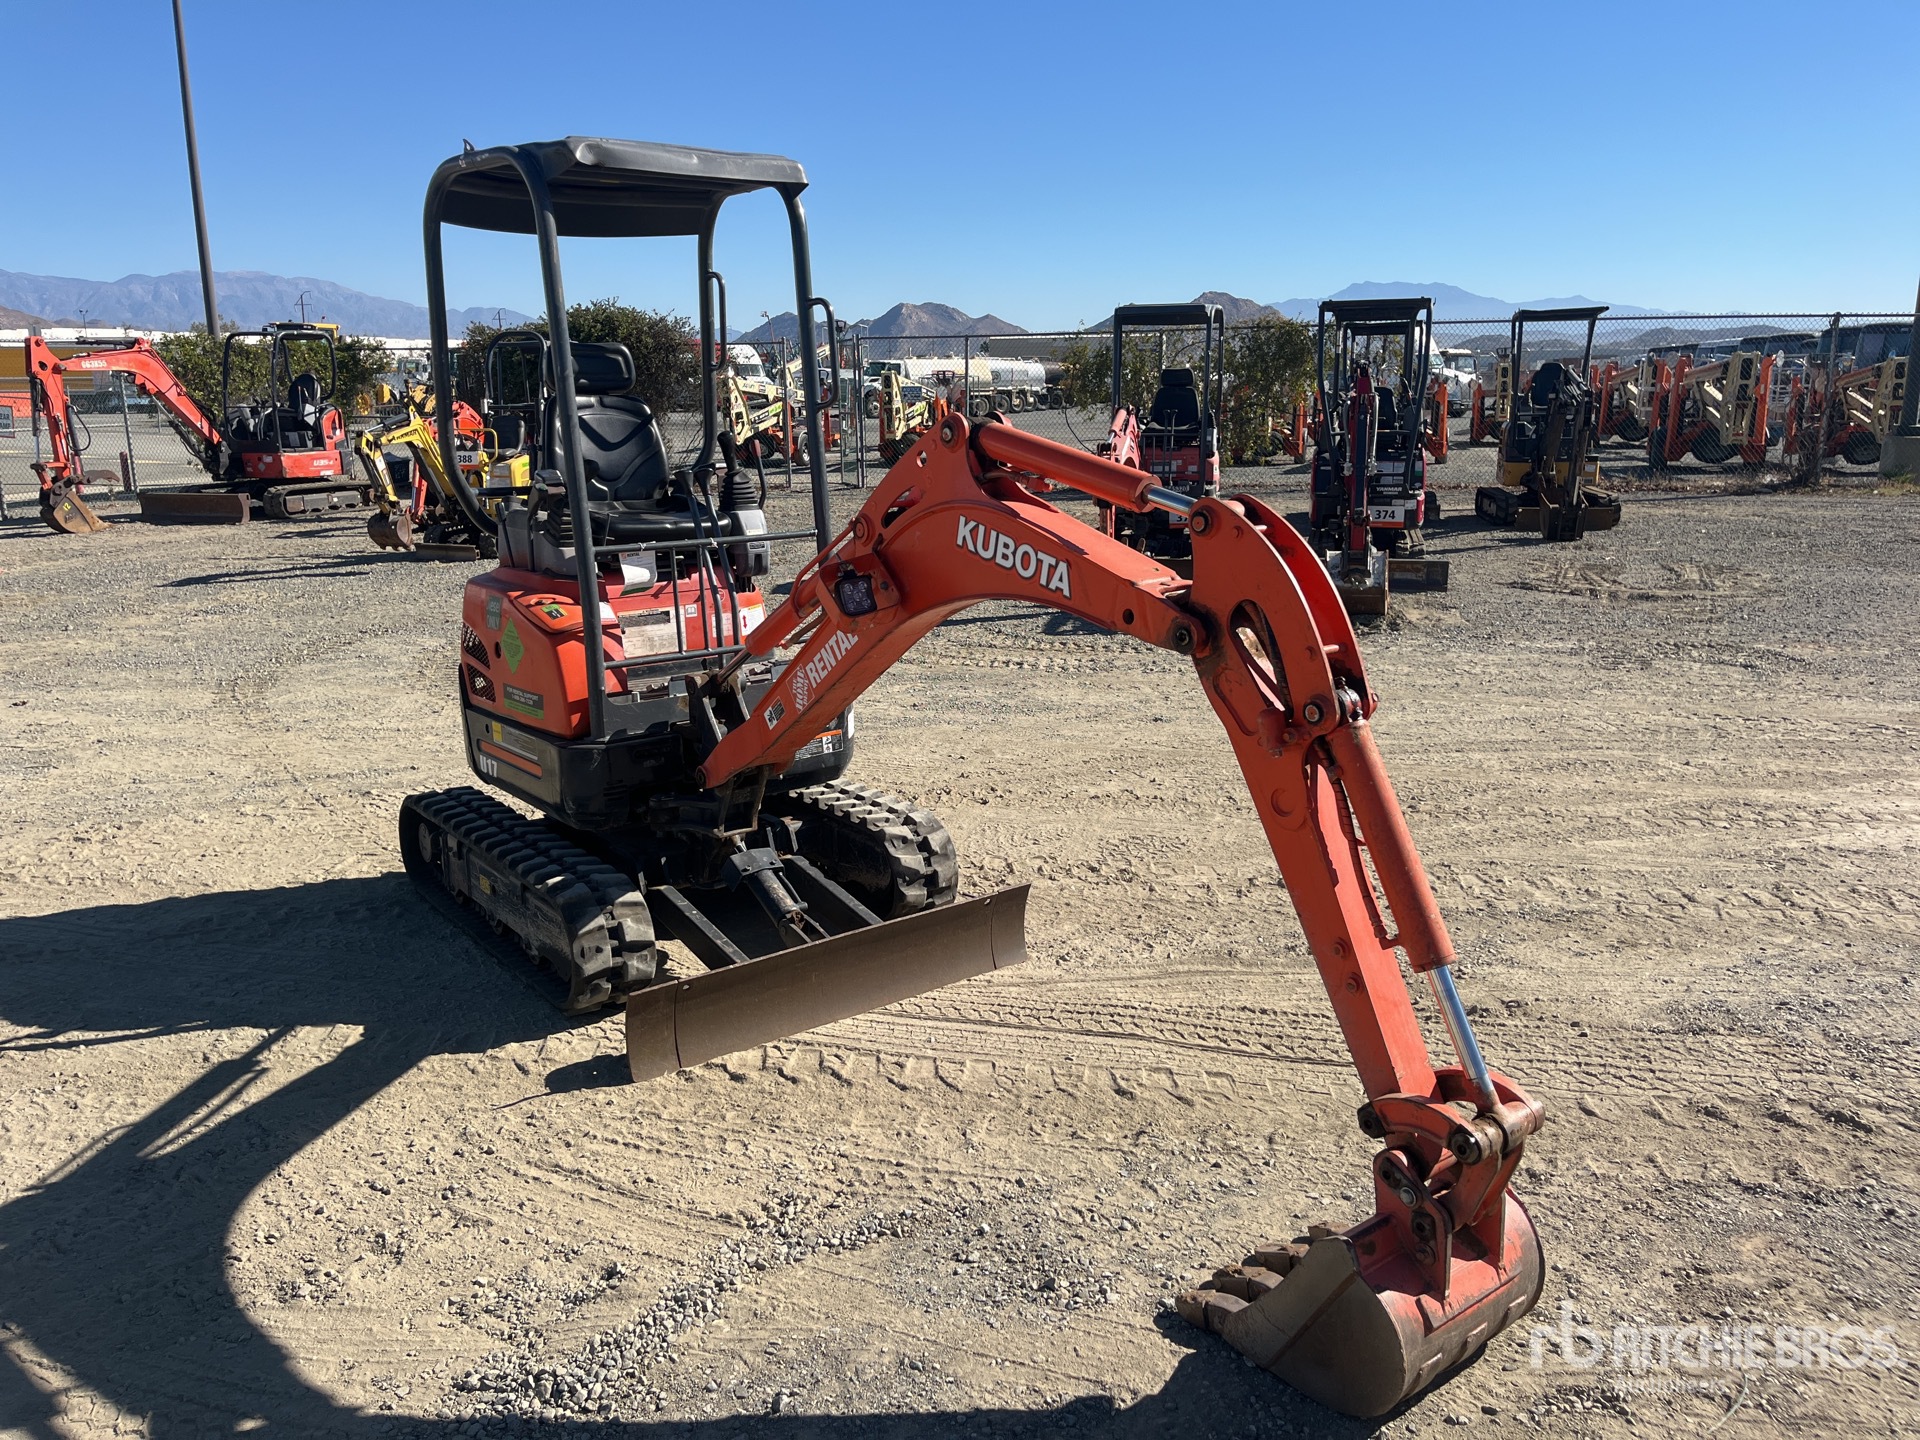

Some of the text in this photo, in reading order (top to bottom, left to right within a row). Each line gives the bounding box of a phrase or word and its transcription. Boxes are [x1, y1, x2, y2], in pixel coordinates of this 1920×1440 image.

[457, 454, 473, 463] 388
[1374, 509, 1396, 520] 374
[956, 515, 1071, 599] KUBOTA
[805, 630, 859, 689] RENTAL
[480, 754, 498, 778] U17
